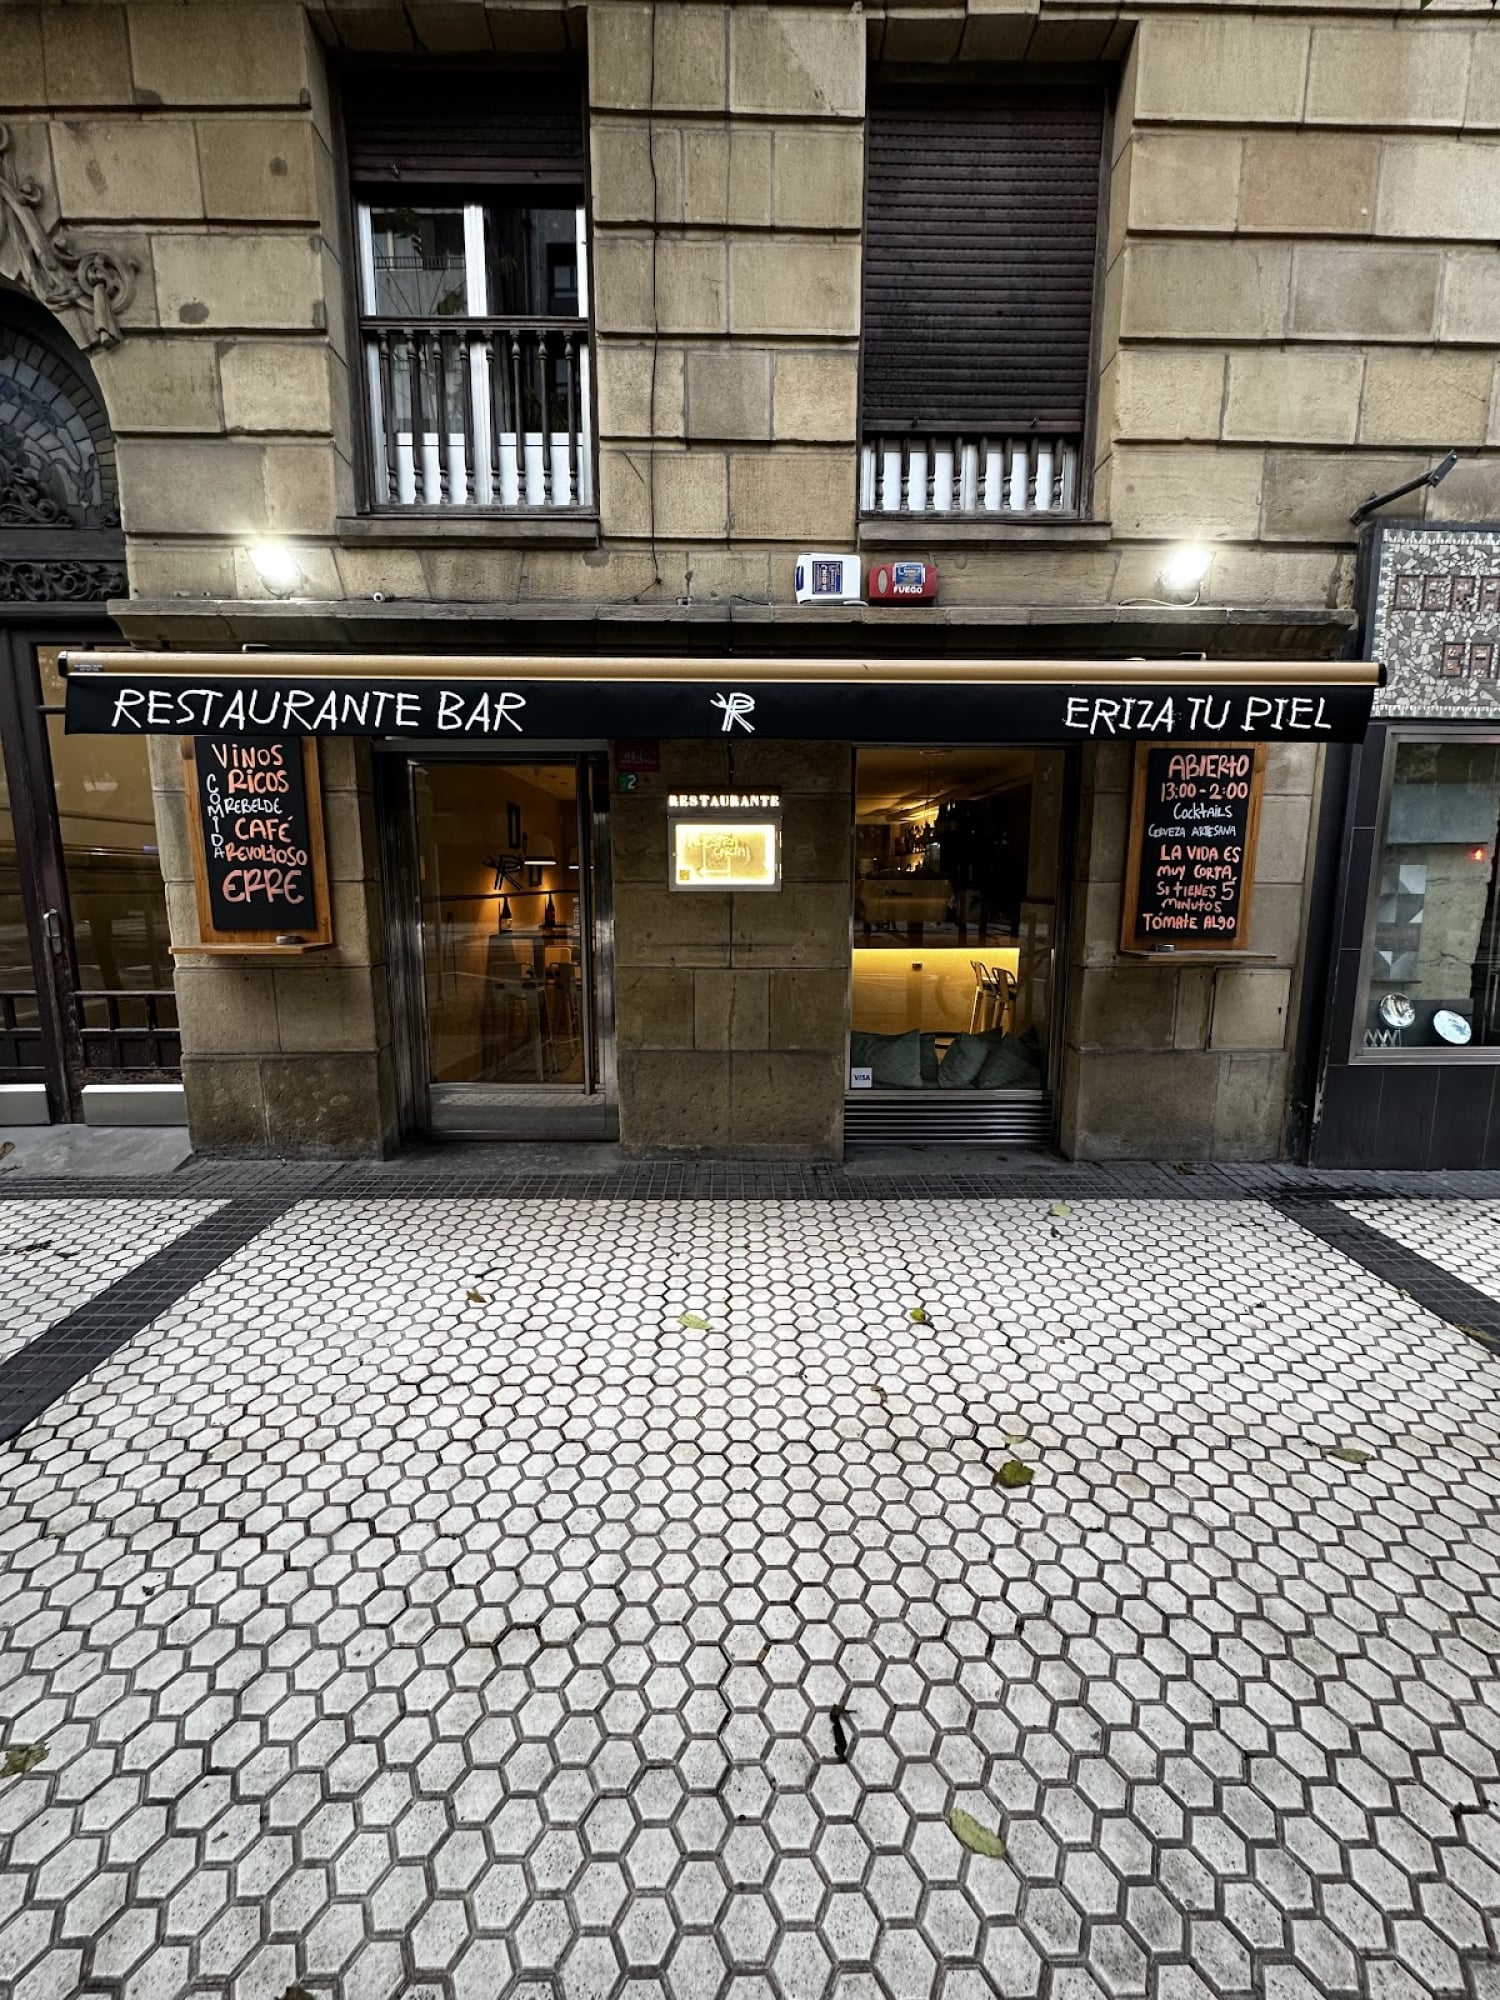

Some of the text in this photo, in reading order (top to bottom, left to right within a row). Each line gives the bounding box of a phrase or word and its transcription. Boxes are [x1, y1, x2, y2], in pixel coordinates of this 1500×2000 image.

[893, 585, 923, 594] FUEGO
[111, 689, 527, 733] RESTAURANTE BAR
[1063, 695, 1332, 734] ERIZA TU PIEL
[224, 797, 283, 815] REBELDE
[668, 794, 780, 808] RESTAURANTE
[234, 815, 294, 843] CAFÉ
[1160, 844, 1241, 863] LA VIDA ES
[1156, 865, 1186, 880] MUY
[222, 869, 305, 904] ERRE
[1221, 880, 1236, 901] 5
